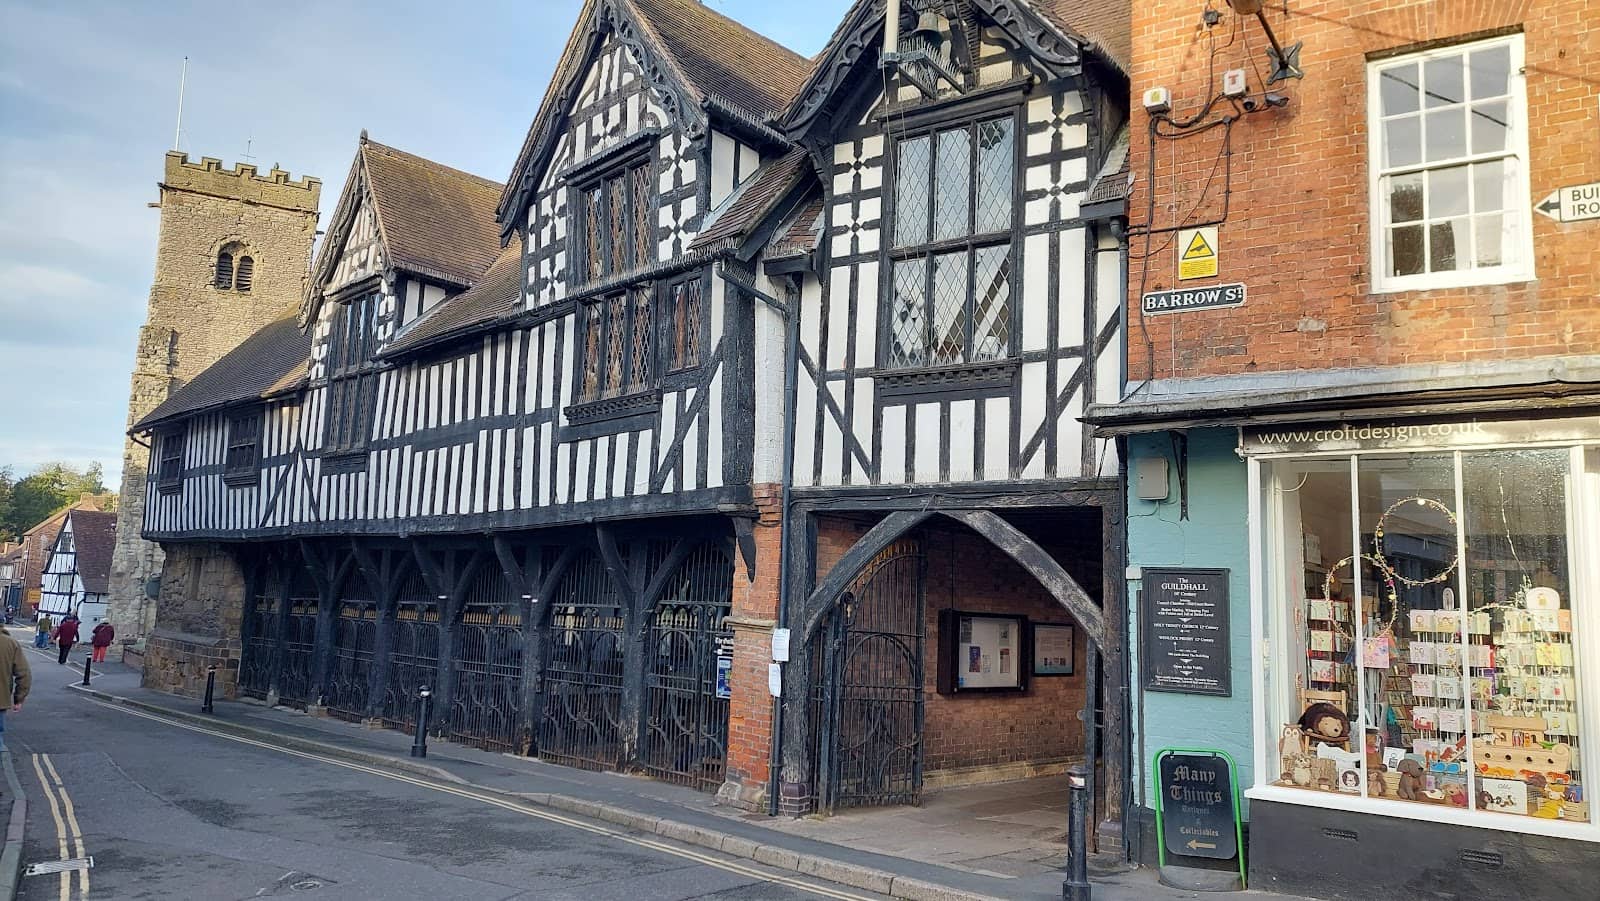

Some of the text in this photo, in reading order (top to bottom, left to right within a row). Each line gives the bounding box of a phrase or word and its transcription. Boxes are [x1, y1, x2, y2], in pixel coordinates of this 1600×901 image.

[1145, 289, 1222, 310] BARROW
[1257, 418, 1485, 444] www.croftdesign.co.uk
[1161, 582, 1209, 591] GUILDHALL
[1173, 765, 1216, 785] Many
[1169, 784, 1222, 806] Things
